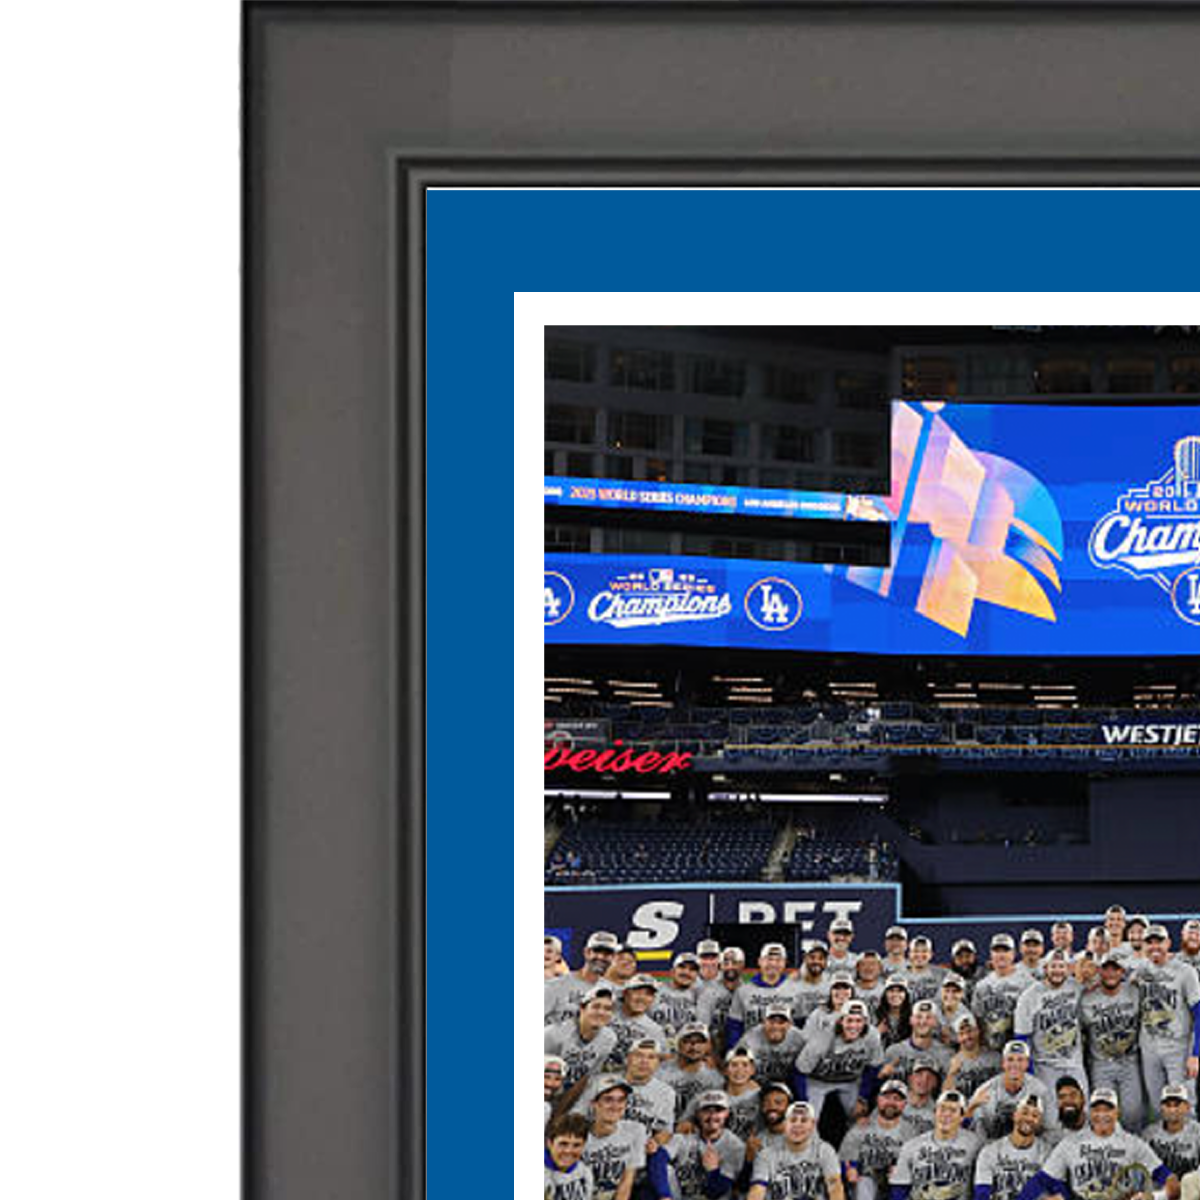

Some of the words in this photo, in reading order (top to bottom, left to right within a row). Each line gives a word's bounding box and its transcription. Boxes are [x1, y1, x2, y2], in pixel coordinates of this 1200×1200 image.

[1124, 499, 1198, 512] WORLD
[587, 588, 733, 624] Champions
[759, 584, 790, 623] LA
